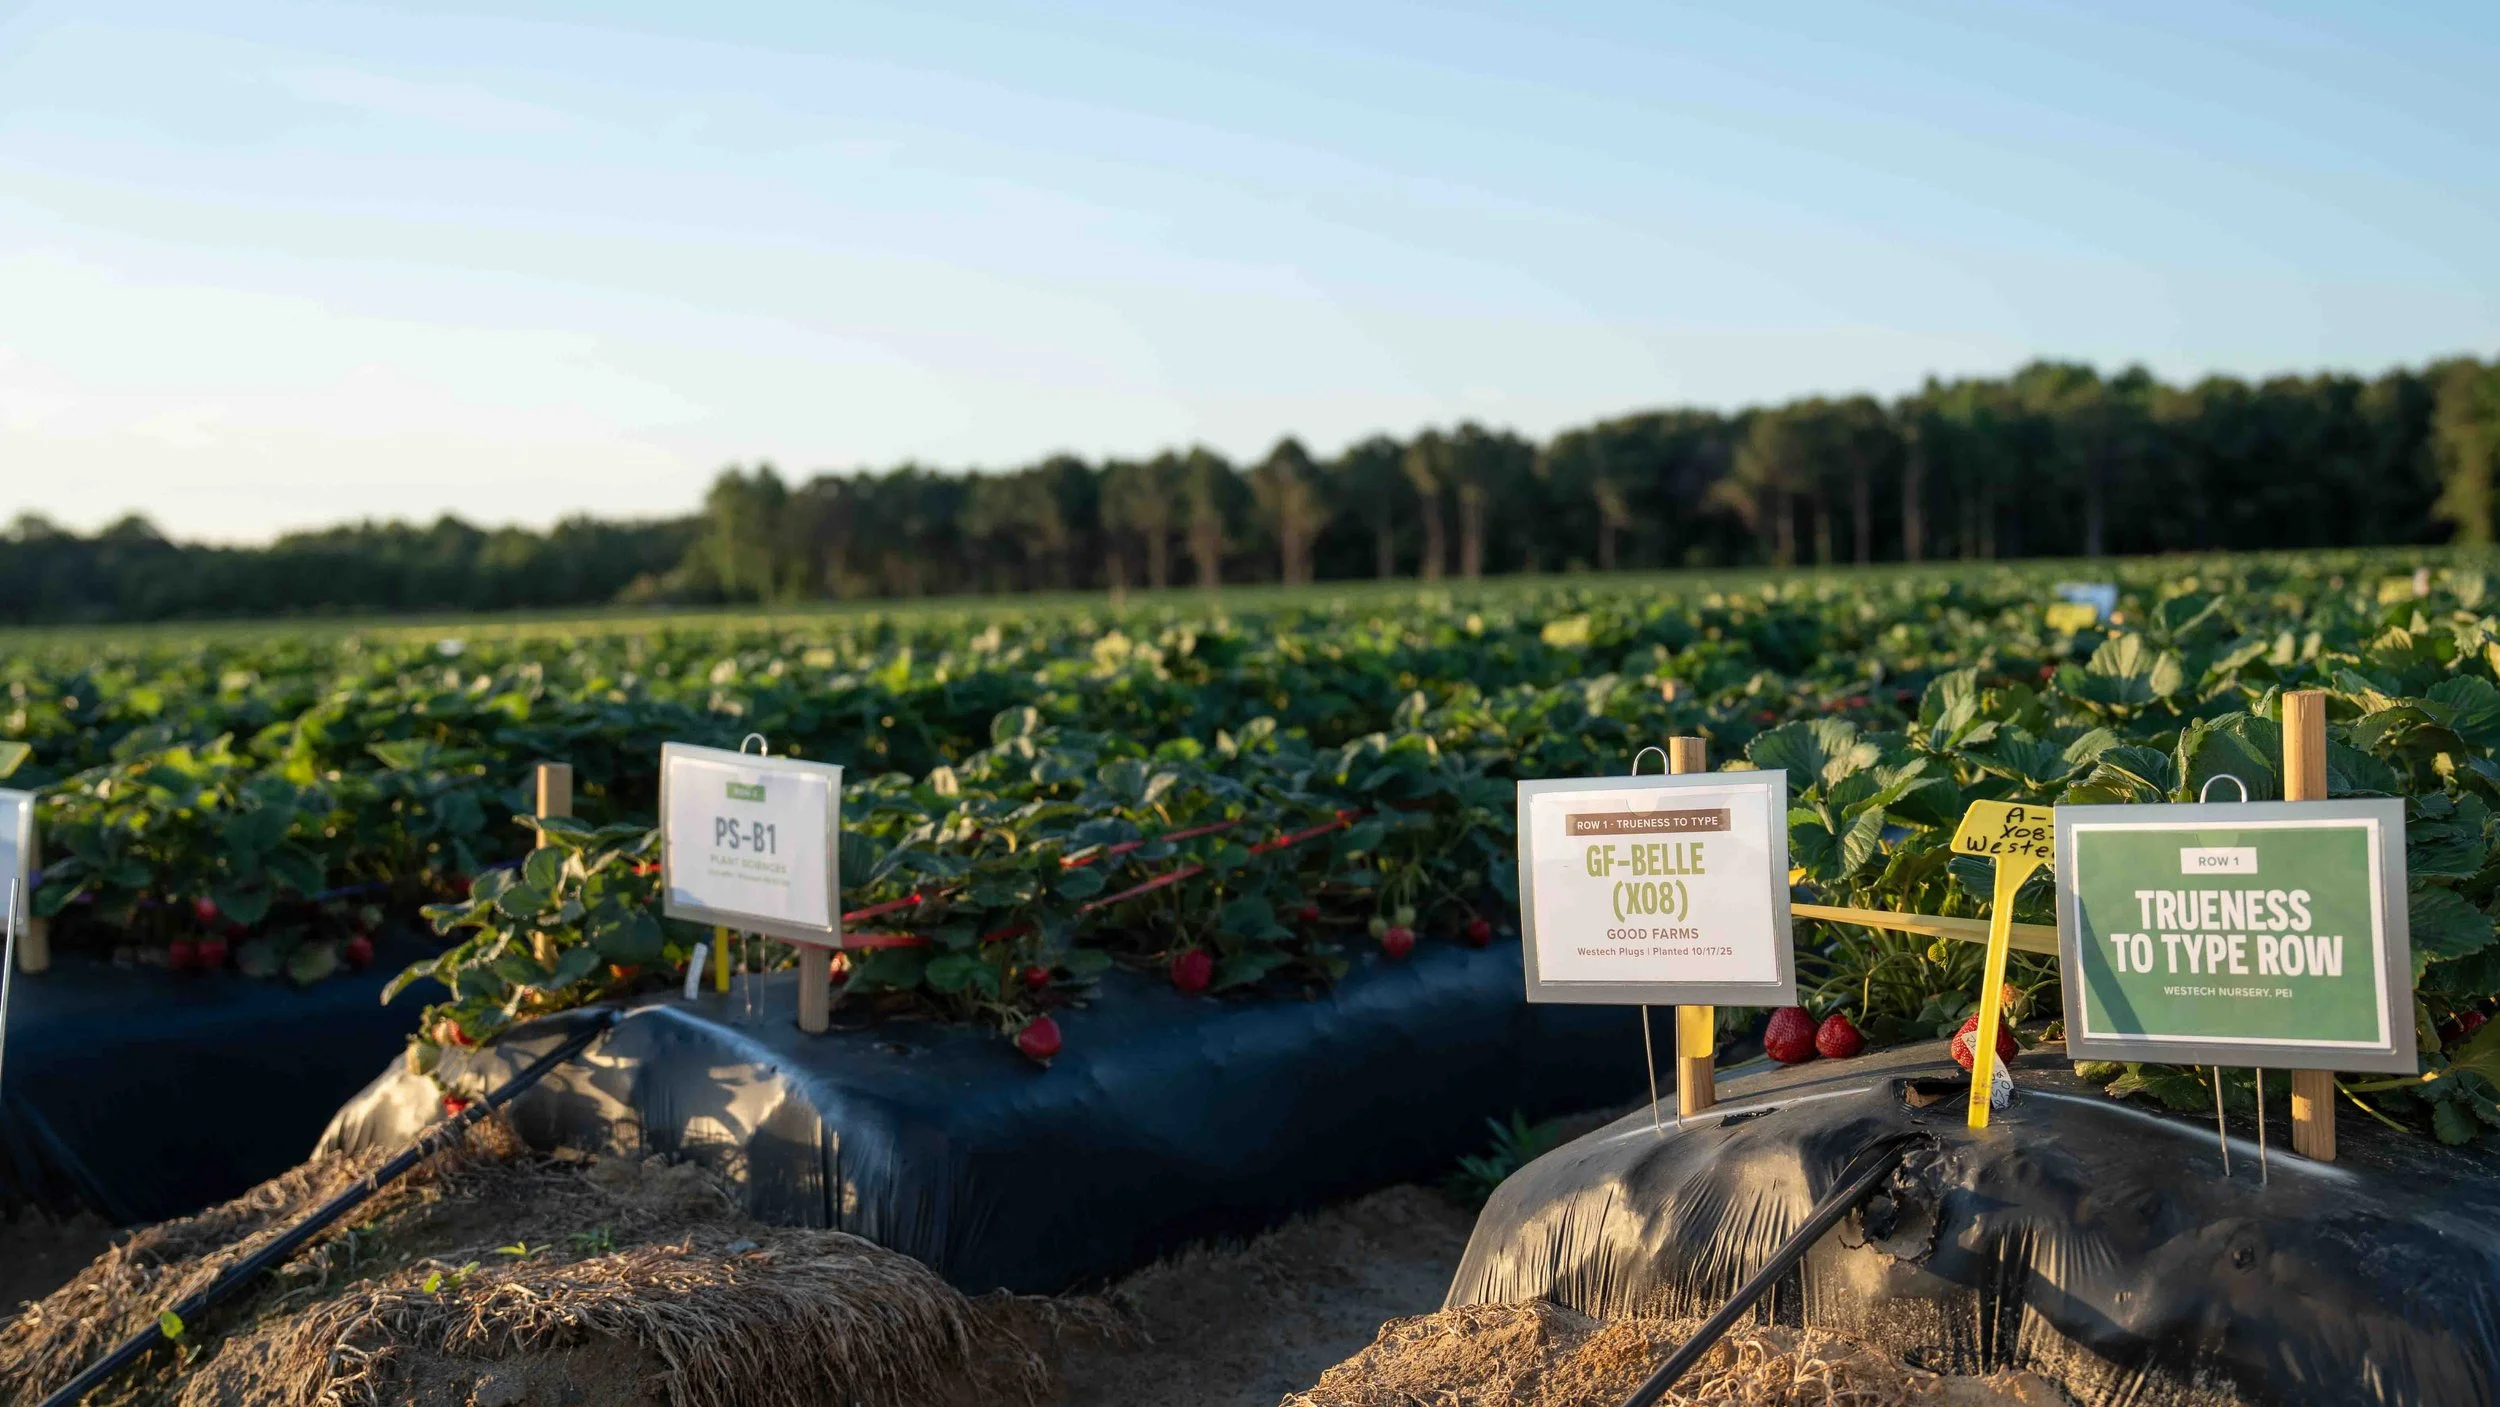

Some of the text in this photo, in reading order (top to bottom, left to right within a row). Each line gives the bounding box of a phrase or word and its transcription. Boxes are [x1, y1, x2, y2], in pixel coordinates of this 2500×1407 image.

[1577, 820, 1600, 830] ROW
[1602, 820, 1608, 829] 1
[1616, 818, 1670, 829] TRUENESS
[1673, 817, 1688, 827] TO
[1690, 816, 1718, 826] TYPE
[716, 816, 776, 855] PS-B1
[1967, 835, 2055, 858] Weste
[1586, 842, 1705, 878] GF-BELLE
[2198, 856, 2239, 866] ROW 1
[1613, 879, 1688, 923] (X08)
[2135, 889, 2312, 931] TRUENESS
[1606, 928, 1699, 940] GOOD FARMS
[1577, 946, 1616, 956] Westech
[1619, 947, 1644, 958] Plugs
[1652, 946, 1689, 956] Planted
[1692, 946, 1732, 957] 10/17/25
[2110, 934, 2343, 977] TO TYPE ROW
[2163, 986, 2215, 996] WESTECH
[2275, 988, 2292, 998] PEI
